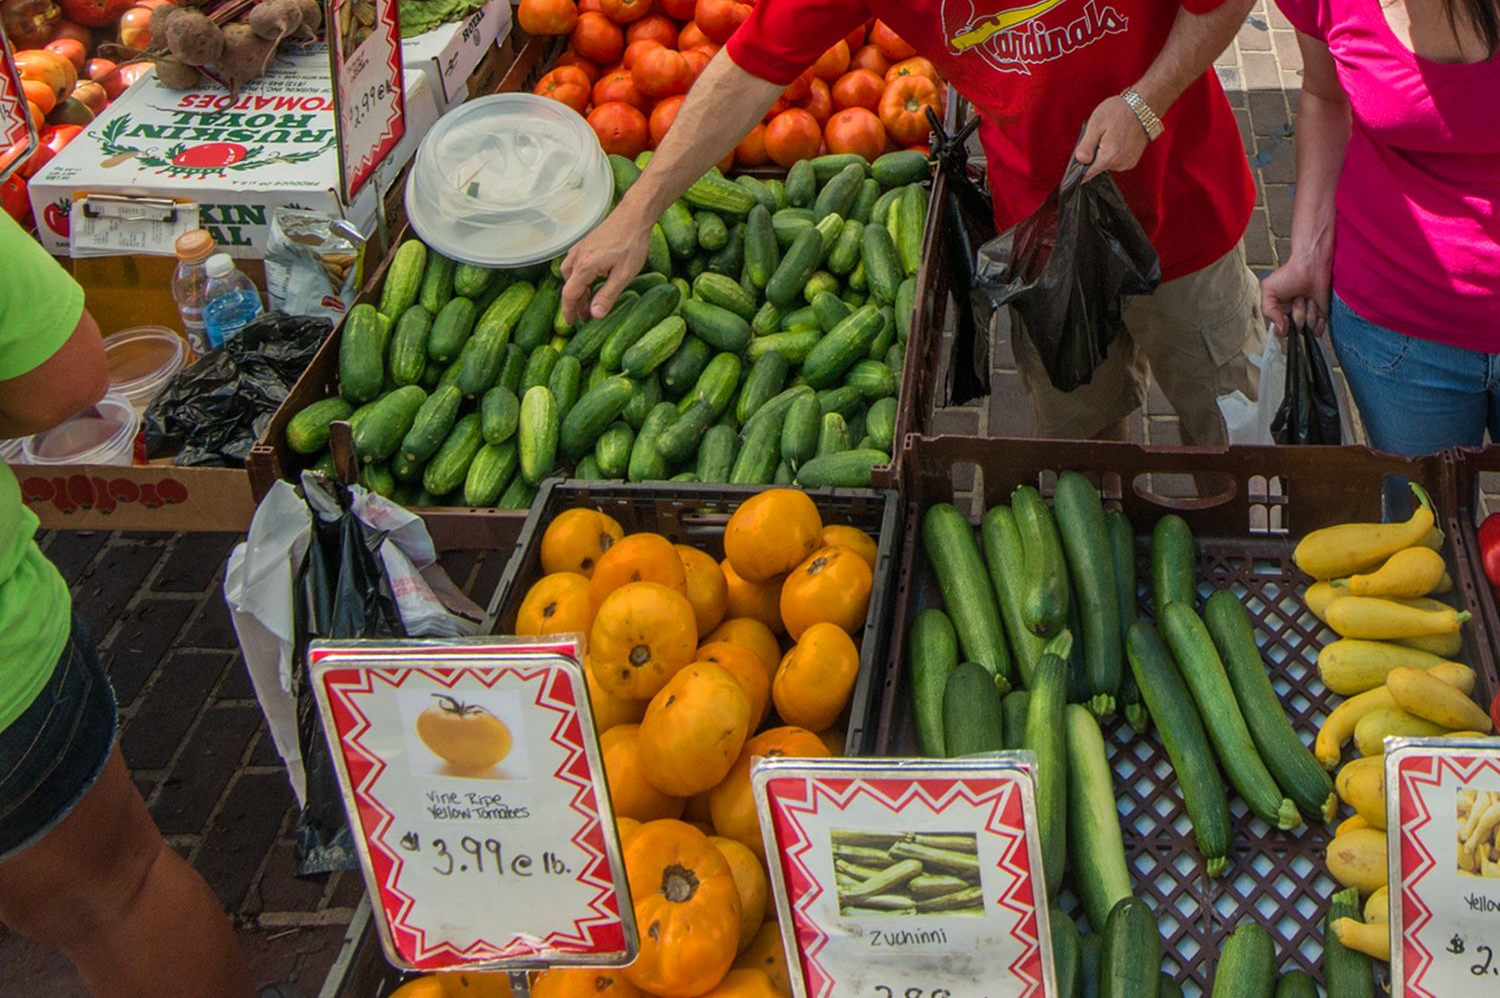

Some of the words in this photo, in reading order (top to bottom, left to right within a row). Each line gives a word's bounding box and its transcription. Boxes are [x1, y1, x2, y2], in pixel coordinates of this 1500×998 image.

[975, 0, 1129, 76] Cardinals
[177, 94, 334, 112] TOMATOES
[173, 110, 316, 130] ROYAL
[124, 123, 336, 145] RUSKIN
[200, 204, 266, 225] KIN
[427, 791, 462, 804] Vine
[464, 792, 504, 807] Ripe
[427, 804, 472, 820] Yellow
[474, 805, 531, 820] Tomatoes
[542, 851, 571, 875] lb.
[870, 928, 949, 947] Zuchinni
